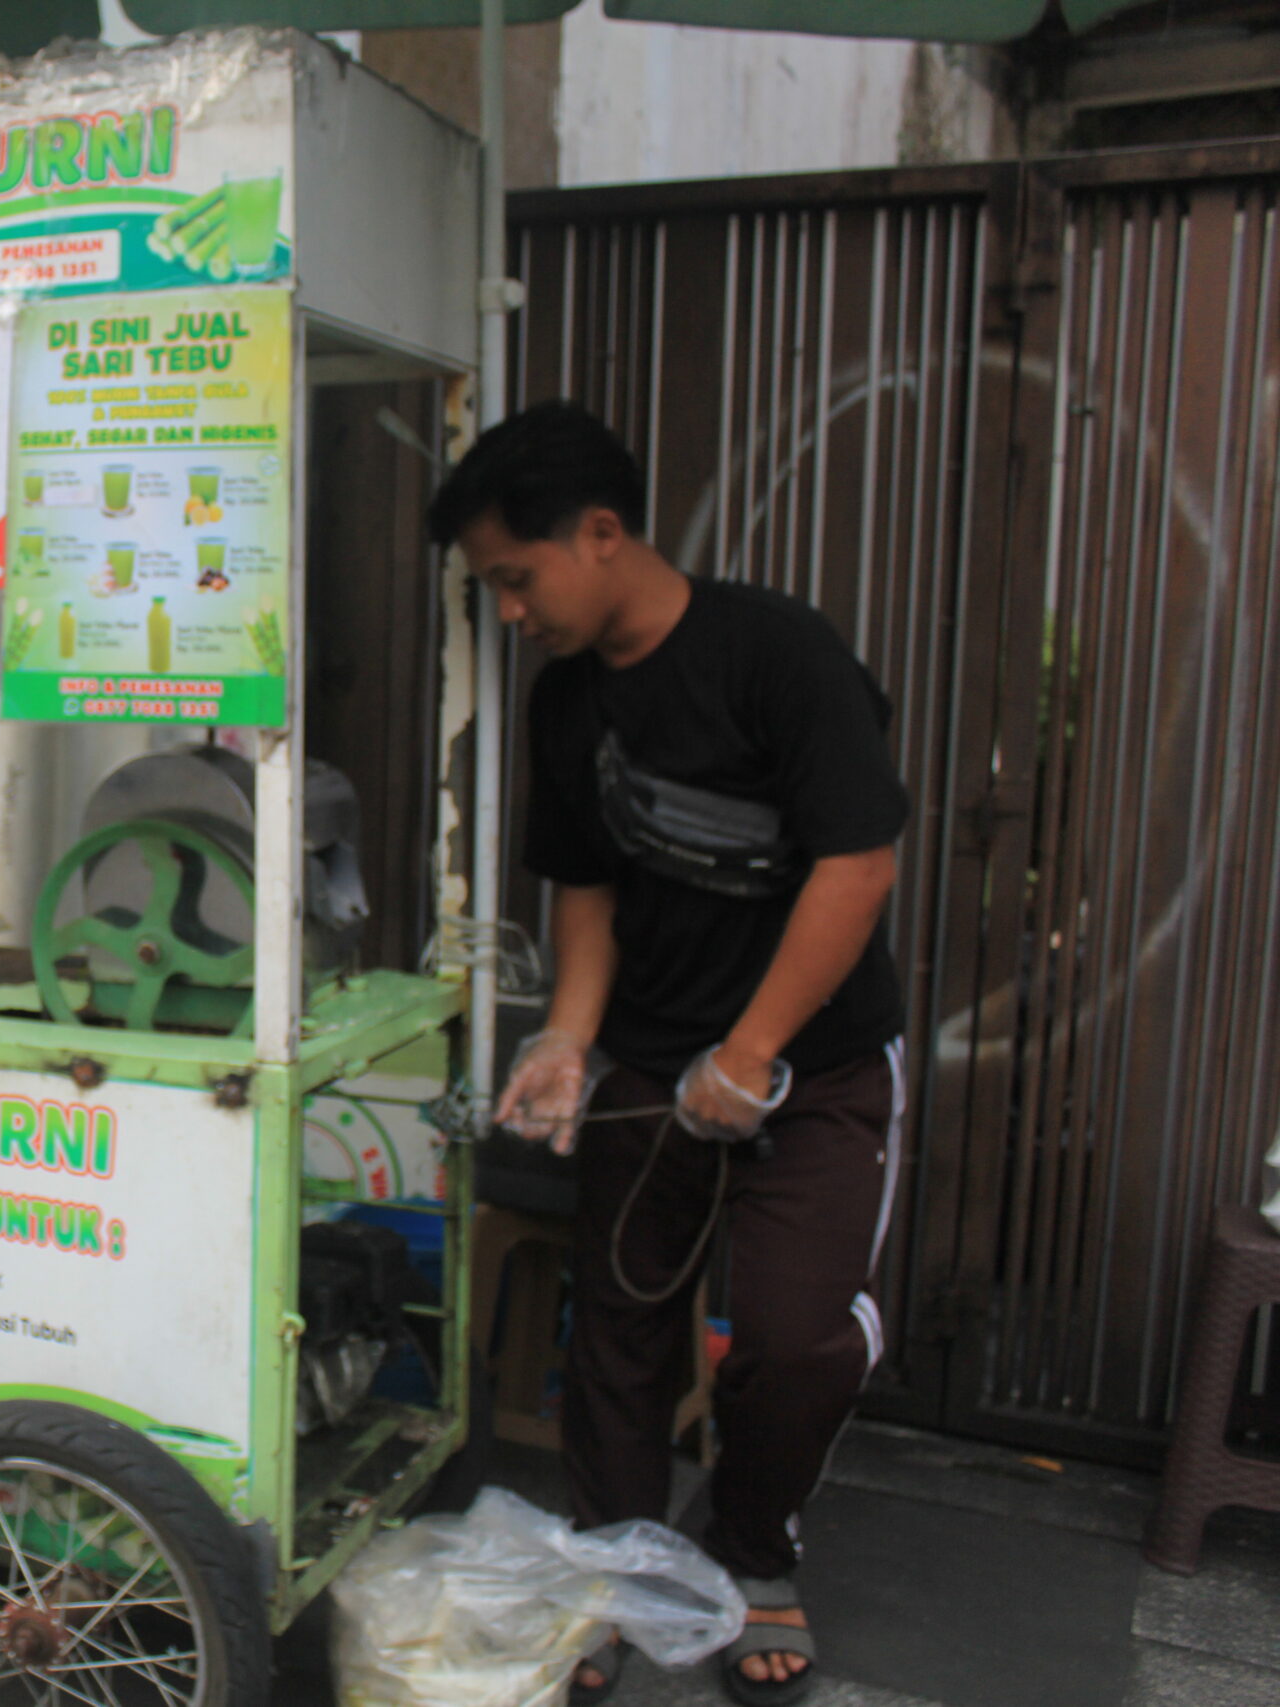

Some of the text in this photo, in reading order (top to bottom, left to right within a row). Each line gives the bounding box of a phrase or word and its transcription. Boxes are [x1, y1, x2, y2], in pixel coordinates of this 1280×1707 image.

[48, 311, 251, 350] DI SINI JUAL
[63, 343, 234, 380] SARI TEBU
[59, 678, 98, 695] INFO
[21, 1317, 77, 1346] Tubuh
